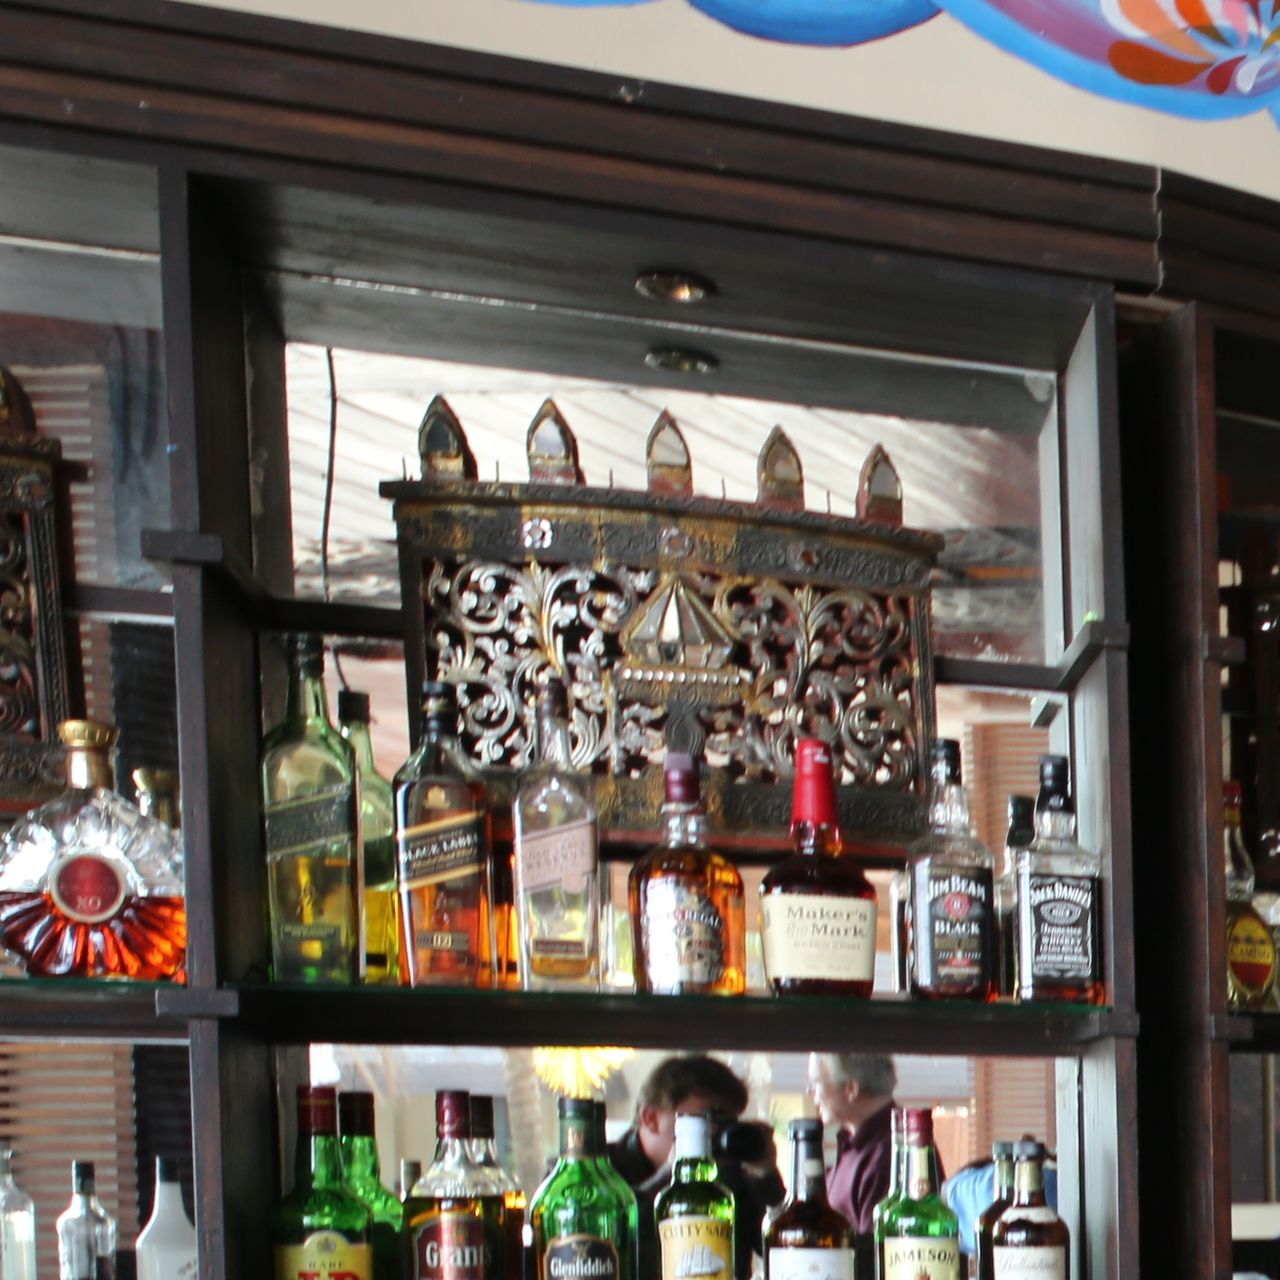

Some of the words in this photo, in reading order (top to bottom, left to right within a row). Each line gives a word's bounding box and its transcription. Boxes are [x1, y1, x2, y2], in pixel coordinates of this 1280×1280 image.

[442, 833, 478, 852] LABEL
[926, 879, 950, 903] JIM
[951, 875, 986, 902] BEAM
[77, 896, 101, 911] XO
[687, 909, 720, 928] REGAL
[787, 906, 868, 922] Maker's
[811, 923, 866, 937] Mark
[935, 920, 980, 935] BLACK
[663, 1223, 701, 1240] CUTTY
[550, 1256, 613, 1276] Glenfiddich
[889, 1248, 955, 1268] JAMESON
